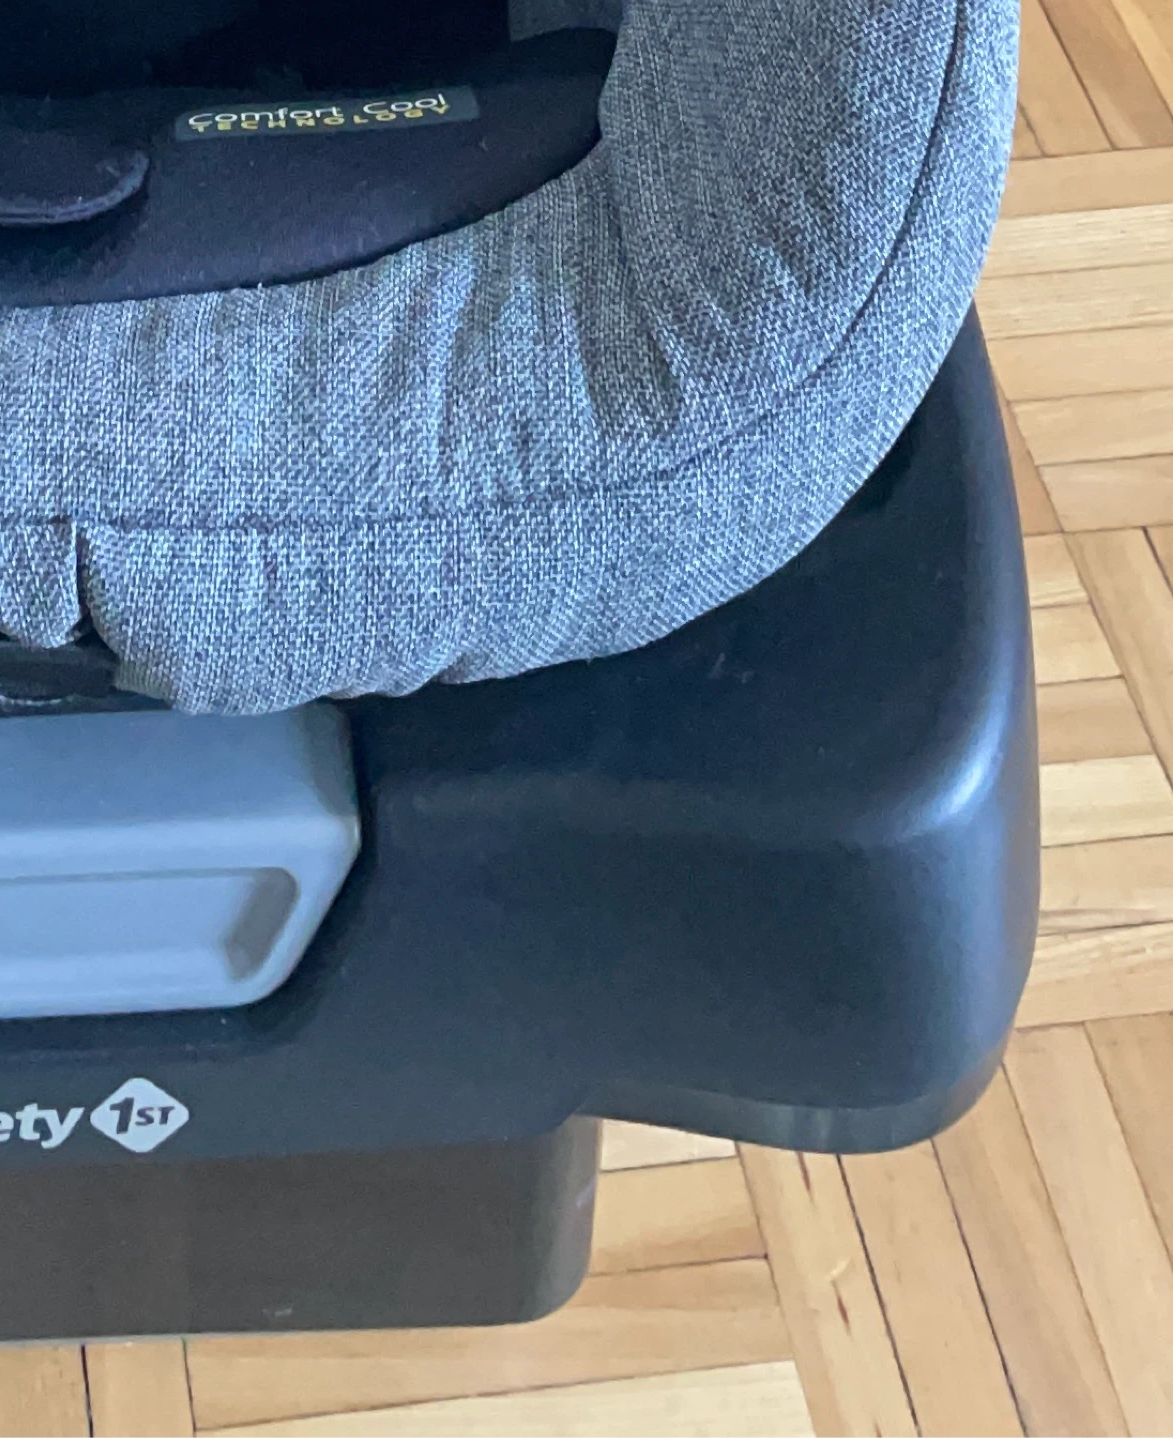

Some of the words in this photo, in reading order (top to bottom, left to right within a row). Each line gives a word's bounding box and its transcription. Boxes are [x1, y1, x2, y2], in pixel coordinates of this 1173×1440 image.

[188, 106, 345, 127] Comfort
[363, 92, 447, 116] Cool
[109, 1096, 176, 1136] 1ST
